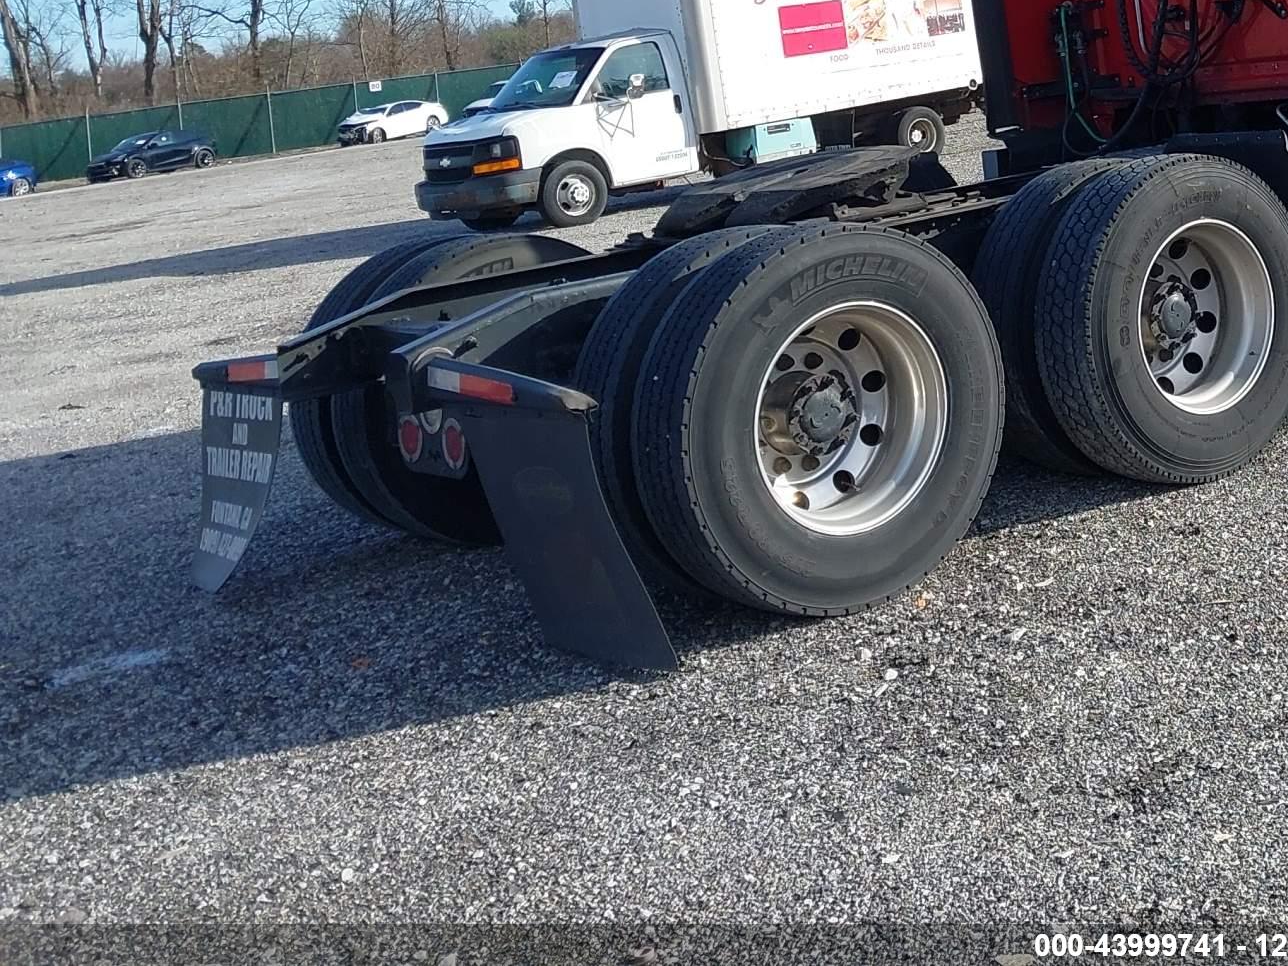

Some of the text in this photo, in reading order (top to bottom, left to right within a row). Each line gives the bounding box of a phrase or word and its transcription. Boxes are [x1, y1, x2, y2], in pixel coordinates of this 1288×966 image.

[876, 40, 936, 56] THOUSAND DETAILS
[790, 253, 928, 301] MICHELIN
[210, 390, 273, 421] P&R TRUCK
[232, 422, 248, 446] AND
[206, 446, 272, 484] TRAILER REPAIR
